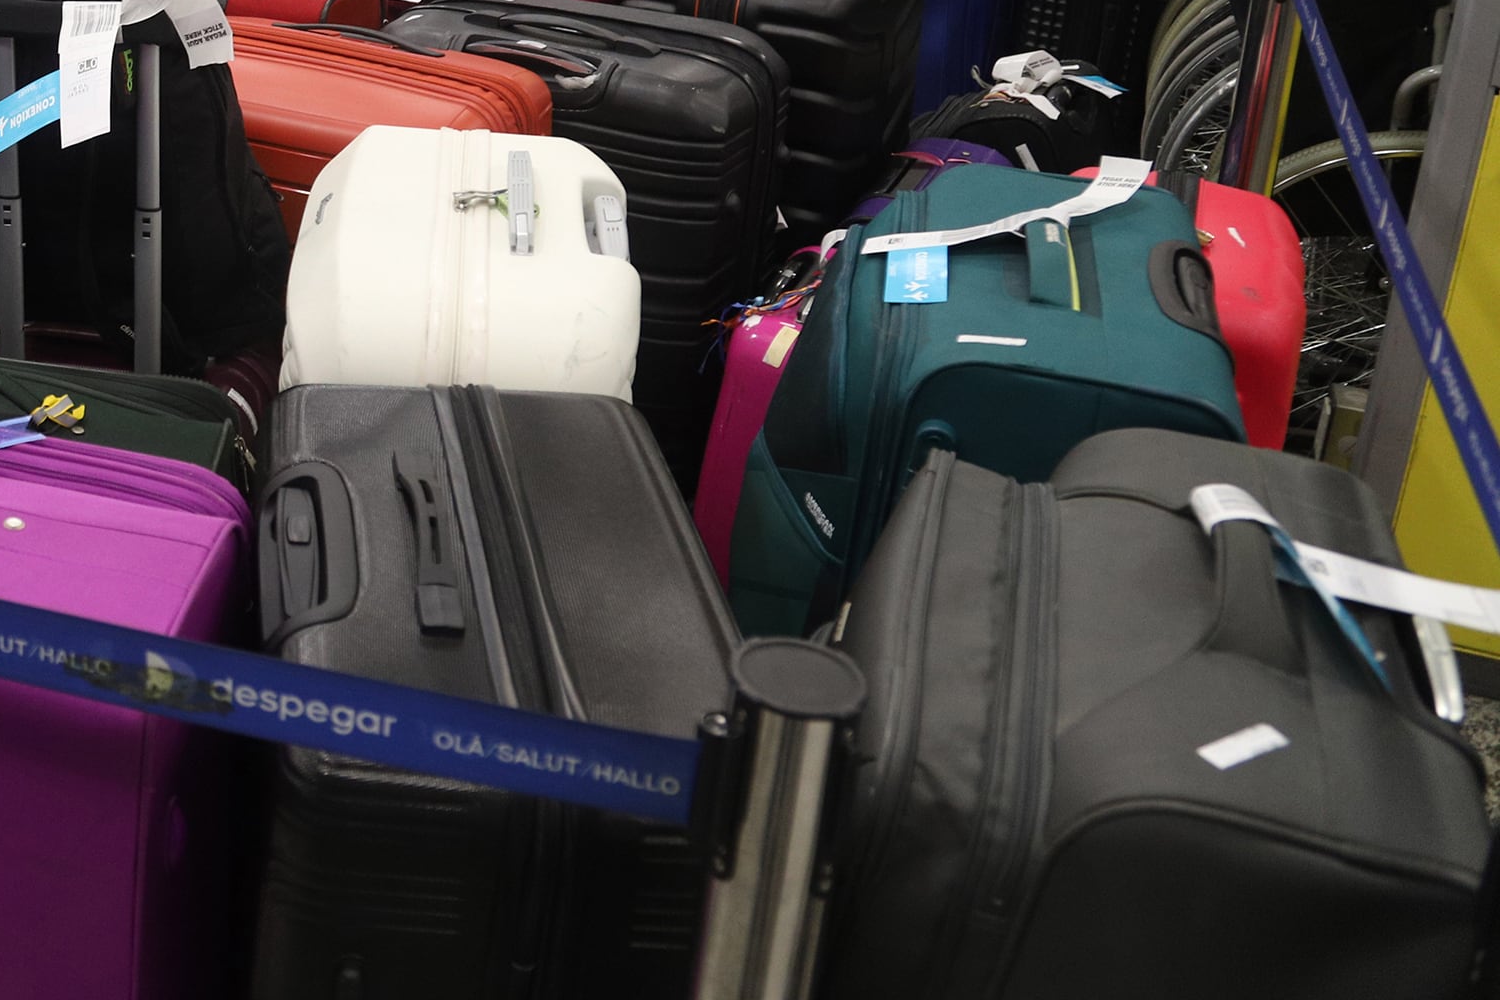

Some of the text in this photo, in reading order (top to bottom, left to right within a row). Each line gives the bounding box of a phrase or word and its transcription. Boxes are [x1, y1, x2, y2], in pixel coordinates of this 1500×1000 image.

[184, 23, 223, 41] STICK HERE
[204, 30, 227, 42] PEGAR
[10, 94, 56, 129] CONEXIÓN
[210, 676, 397, 738] despegar
